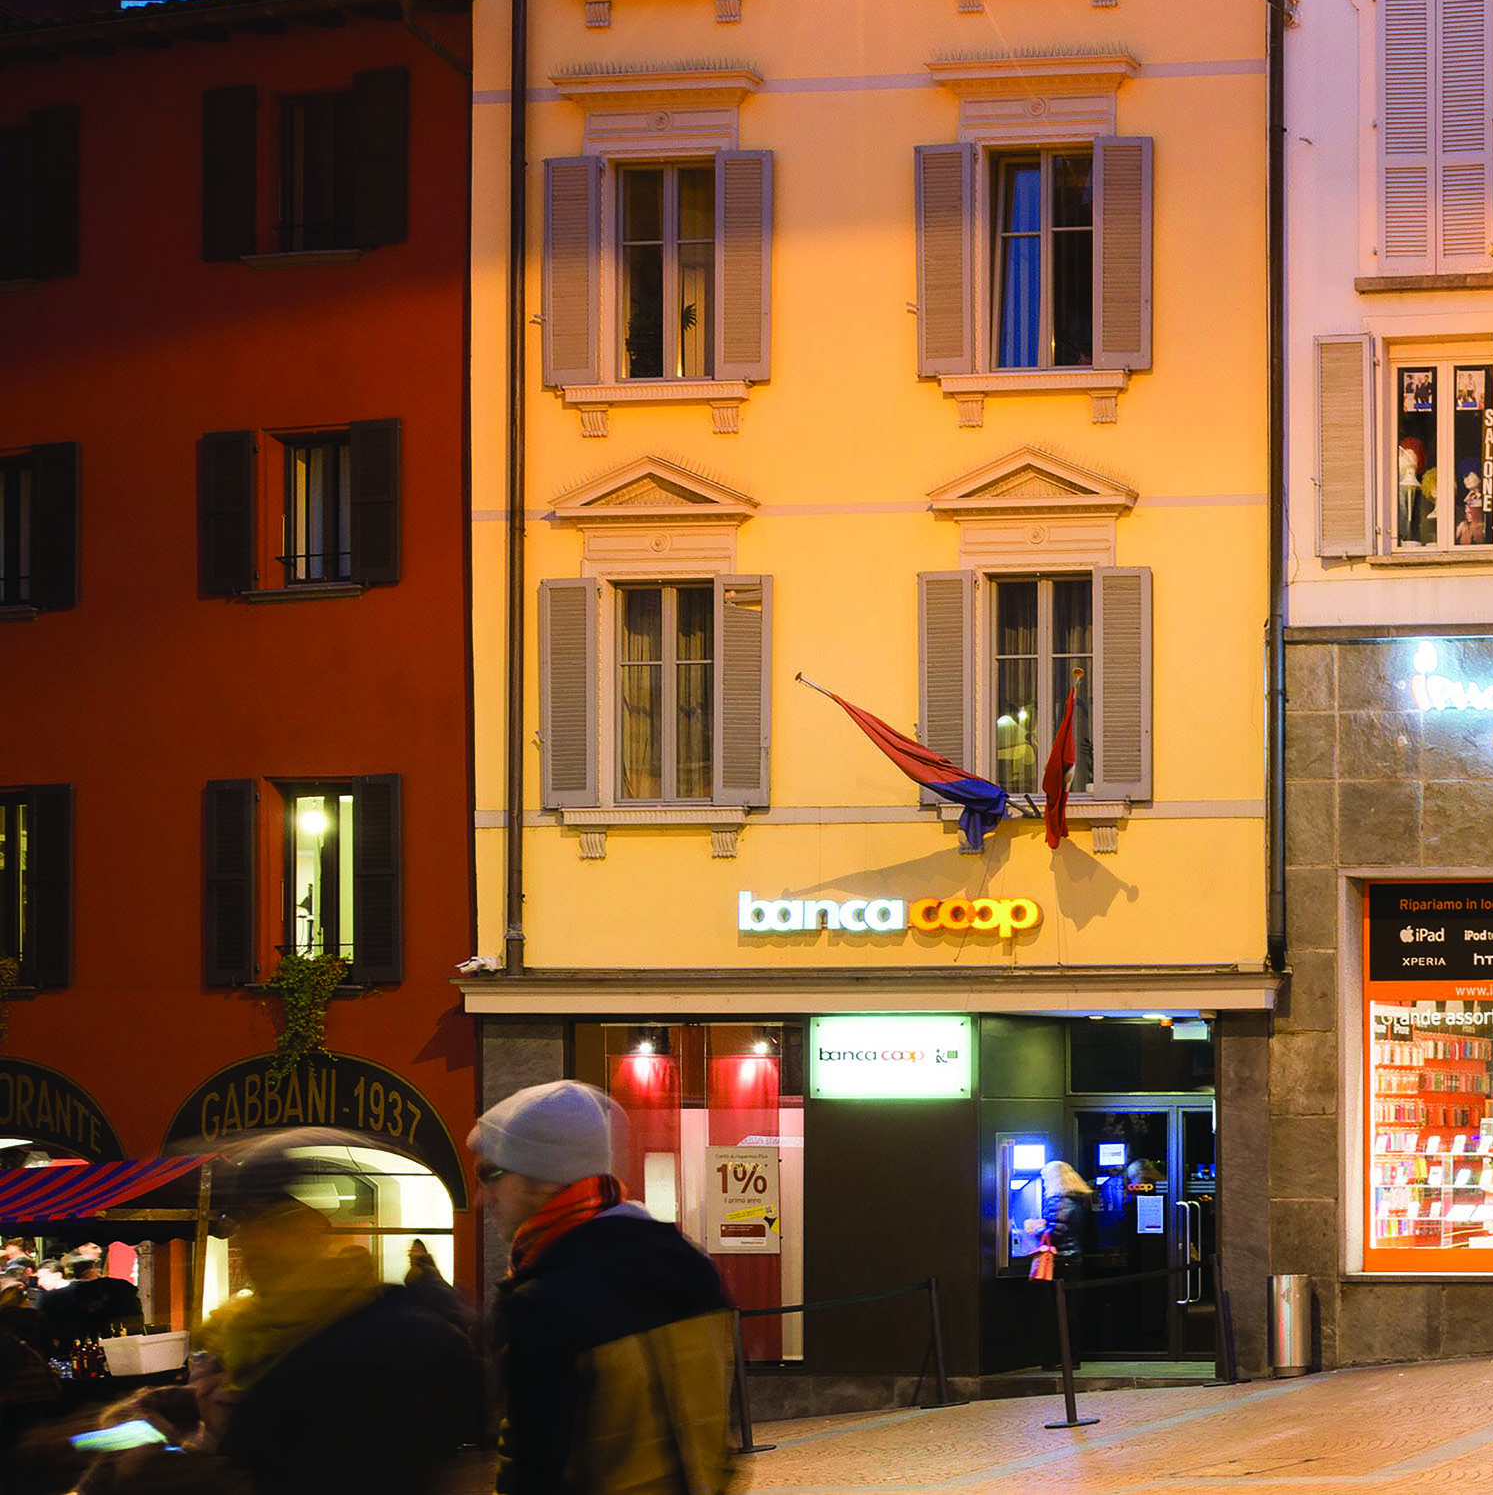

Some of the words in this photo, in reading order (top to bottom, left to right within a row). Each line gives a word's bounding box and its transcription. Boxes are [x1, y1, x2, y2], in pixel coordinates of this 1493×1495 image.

[1400, 897, 1463, 912] Ripariamo
[1466, 897, 1477, 910] in
[738, 890, 905, 932] banca
[908, 897, 1040, 938] coop
[1415, 927, 1445, 942] iPad
[1464, 929, 1487, 941] iPod
[1402, 957, 1447, 966] XPERIA
[819, 1047, 877, 1061] banca
[881, 1050, 925, 1063] coop
[202, 1069, 337, 1143] GABBANI
[354, 1076, 422, 1145] 1937
[716, 1163, 768, 1194] 1%
